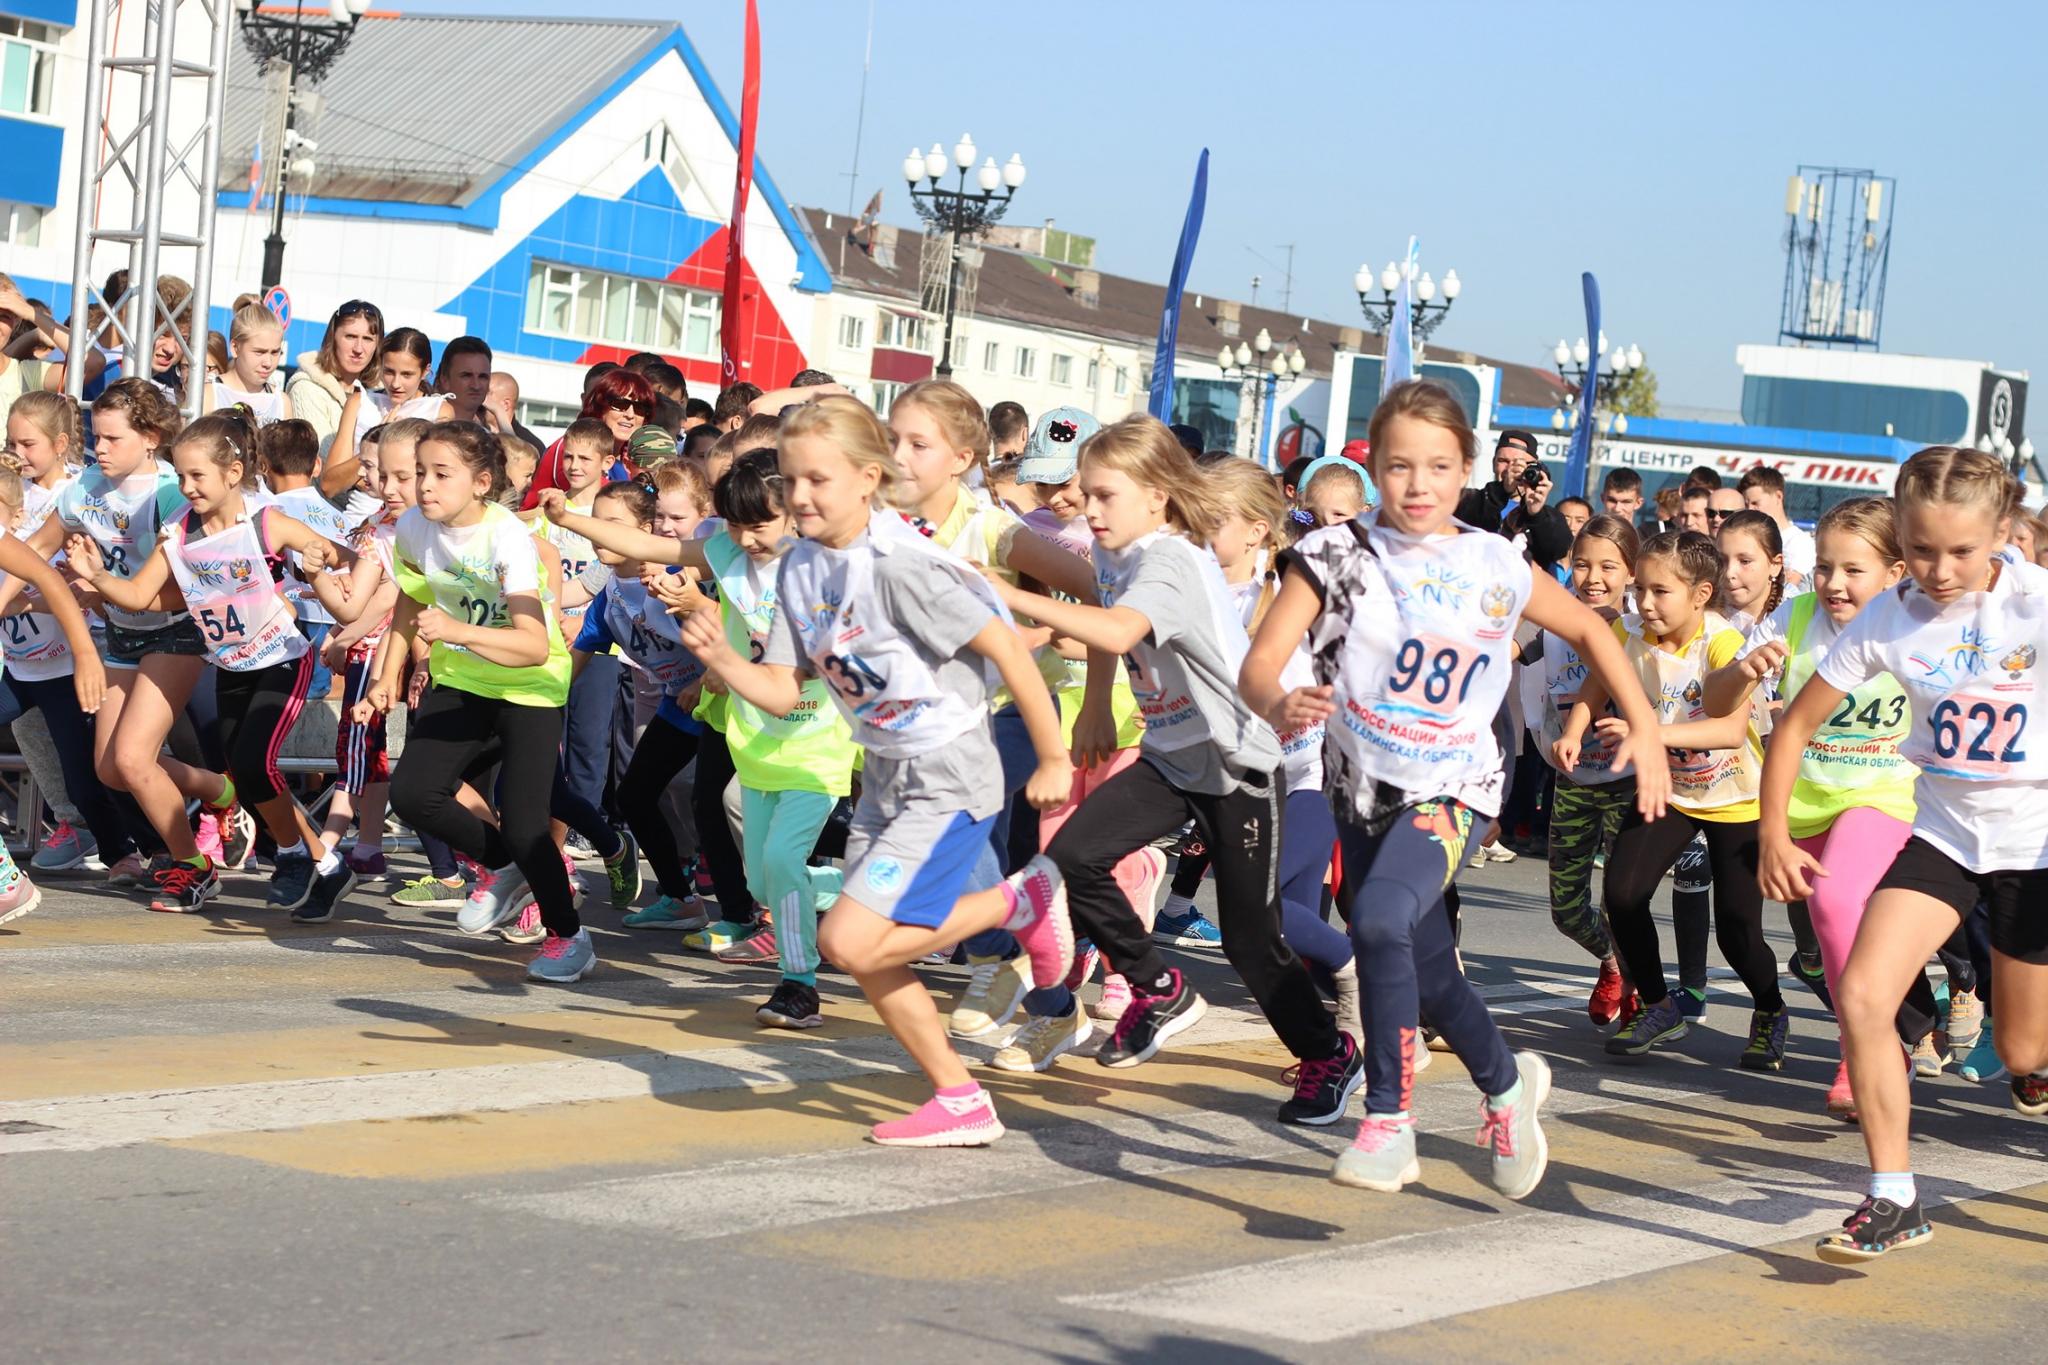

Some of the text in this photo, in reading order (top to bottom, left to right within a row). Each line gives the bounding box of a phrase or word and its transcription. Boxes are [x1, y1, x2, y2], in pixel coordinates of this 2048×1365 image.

[1620, 450, 1694, 468] ЦЕНТР
[1716, 454, 1796, 478] ЧАС
[1802, 462, 1885, 485] ПИК
[194, 603, 246, 643] 54
[261, 624, 281, 643] 2018
[1388, 723, 1438, 745] НАЦИИ
[1446, 732, 1477, 747] 2018
[1933, 699, 2028, 763] 622
[1803, 750, 1868, 767] АХАЛИНСКАЯ
[1807, 740, 1838, 753] РОСС
